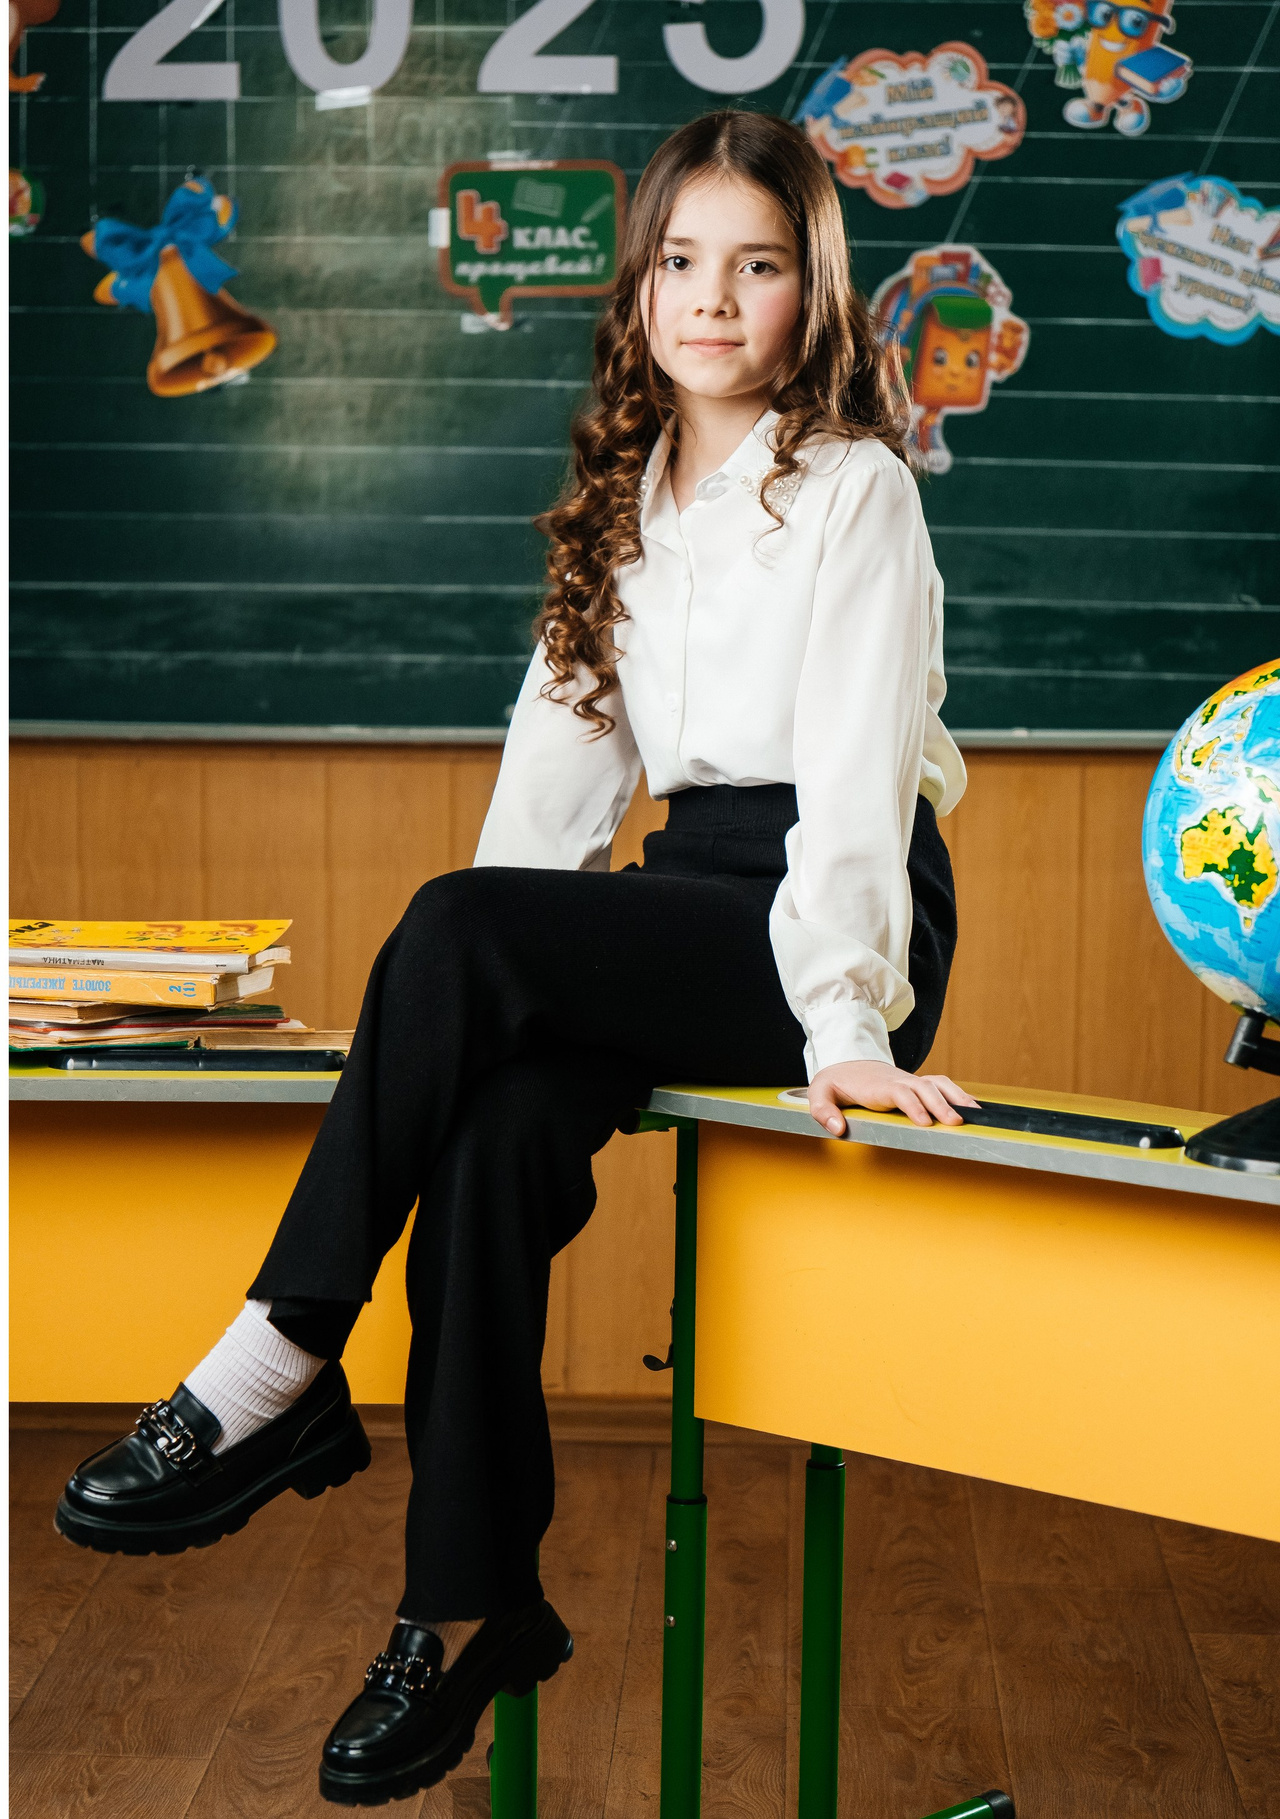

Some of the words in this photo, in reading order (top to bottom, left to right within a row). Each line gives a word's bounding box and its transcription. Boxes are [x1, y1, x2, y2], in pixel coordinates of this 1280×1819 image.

[456, 189, 508, 254] 4
[42, 957, 105, 966] МАТЕМАТИКА
[9, 976, 66, 990] ДЖЕРЕЛЬЦ
[72, 979, 111, 992] ЗОЛОТЕ
